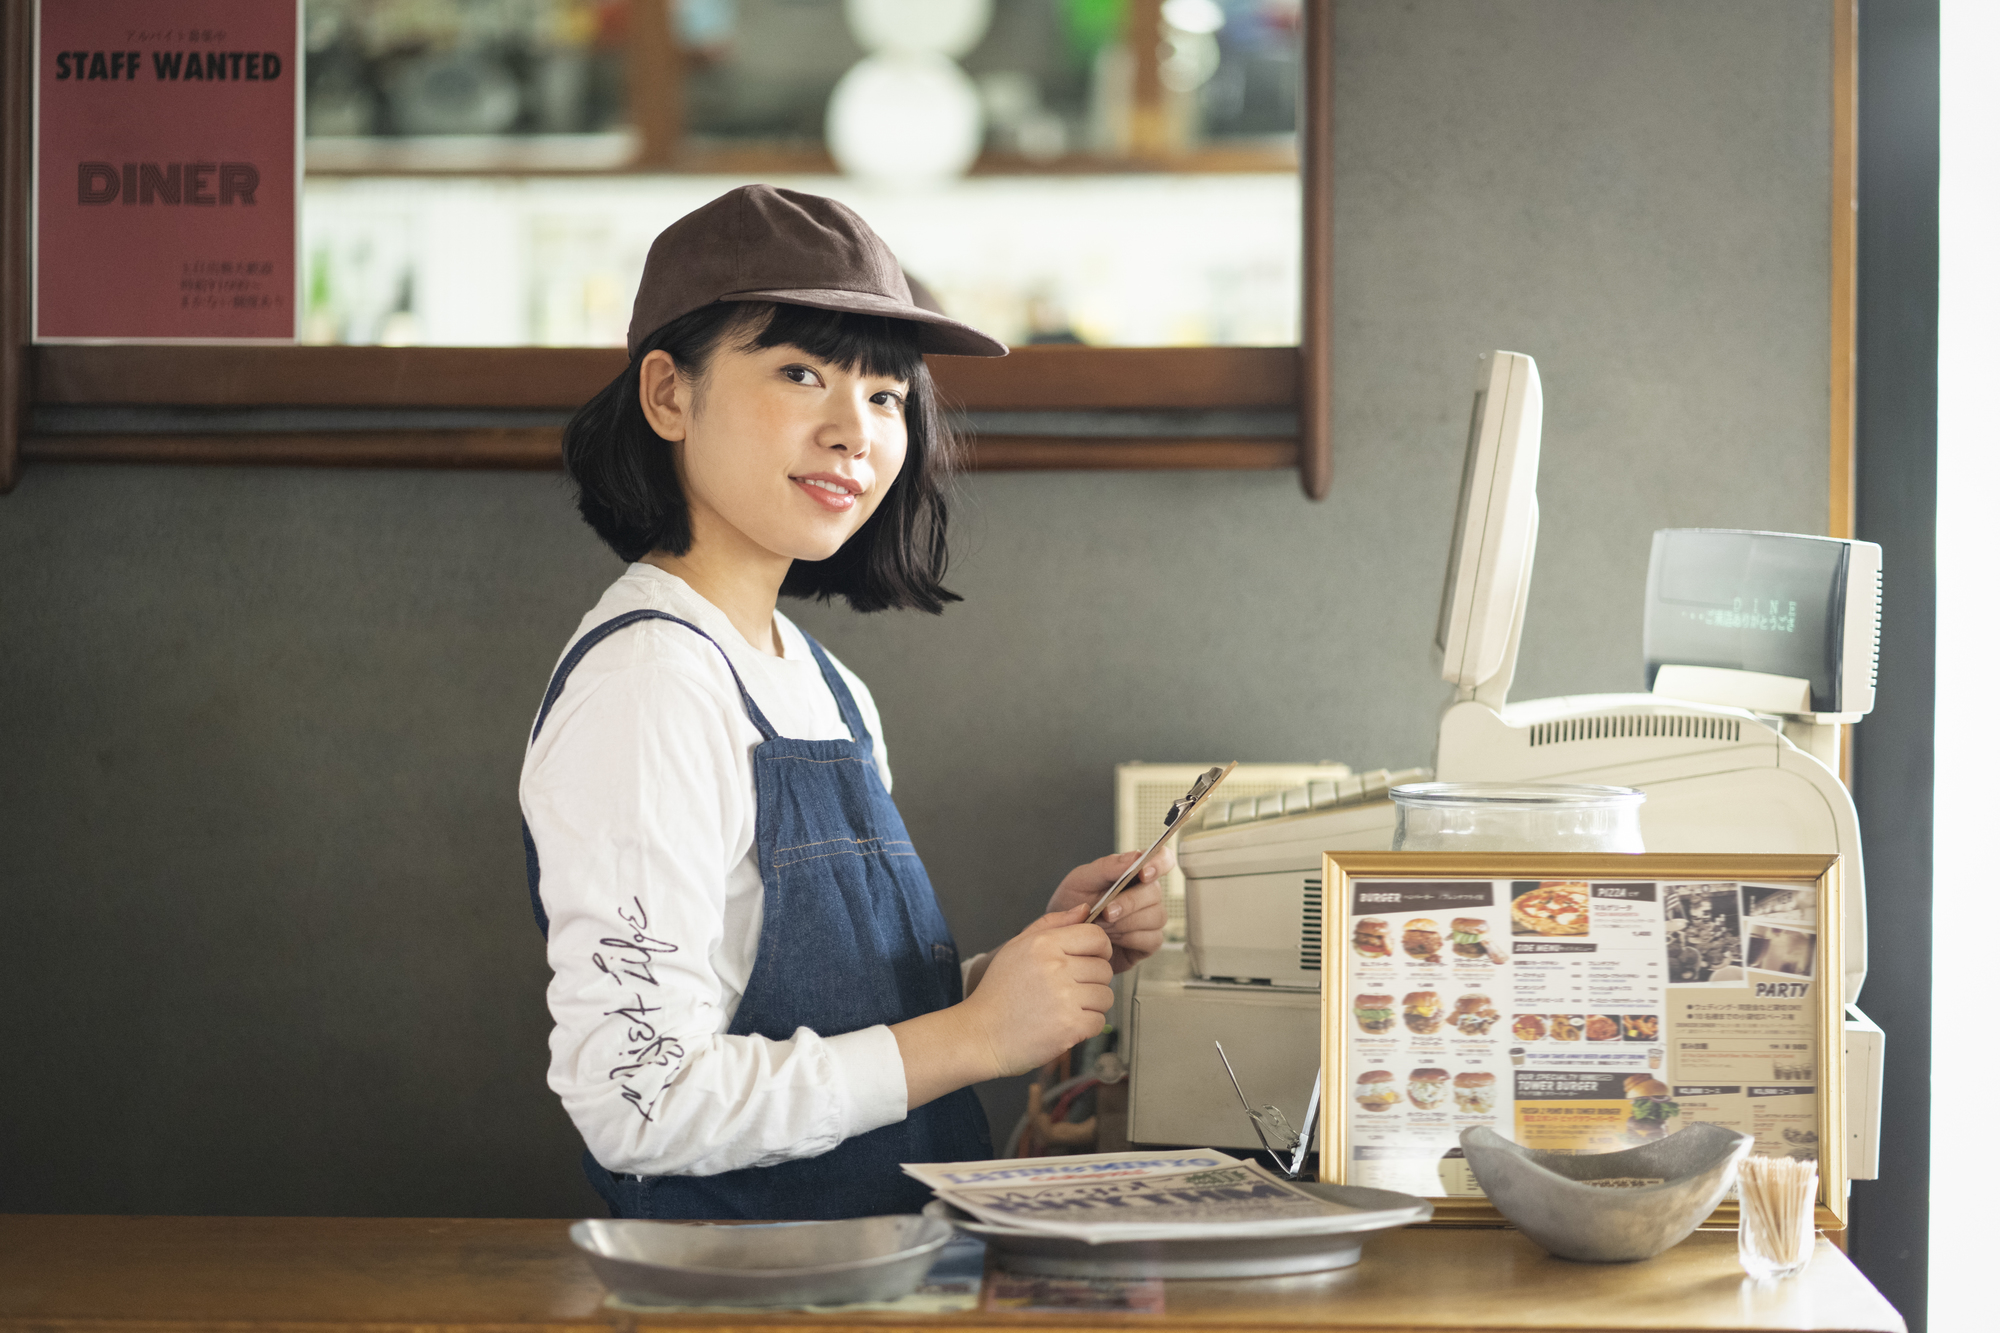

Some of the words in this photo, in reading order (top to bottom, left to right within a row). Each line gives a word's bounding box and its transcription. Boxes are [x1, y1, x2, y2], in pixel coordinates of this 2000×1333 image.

[56, 51, 141, 81] STAFF
[152, 51, 282, 81] WANTED
[78, 162, 260, 206] DINER
[1359, 892, 1401, 903] BURGER
[1596, 886, 1627, 898] PIZZA
[1755, 982, 1810, 998] PARTY
[1518, 1081, 1555, 1091] TOWER
[1556, 1081, 1598, 1091] BURGER
